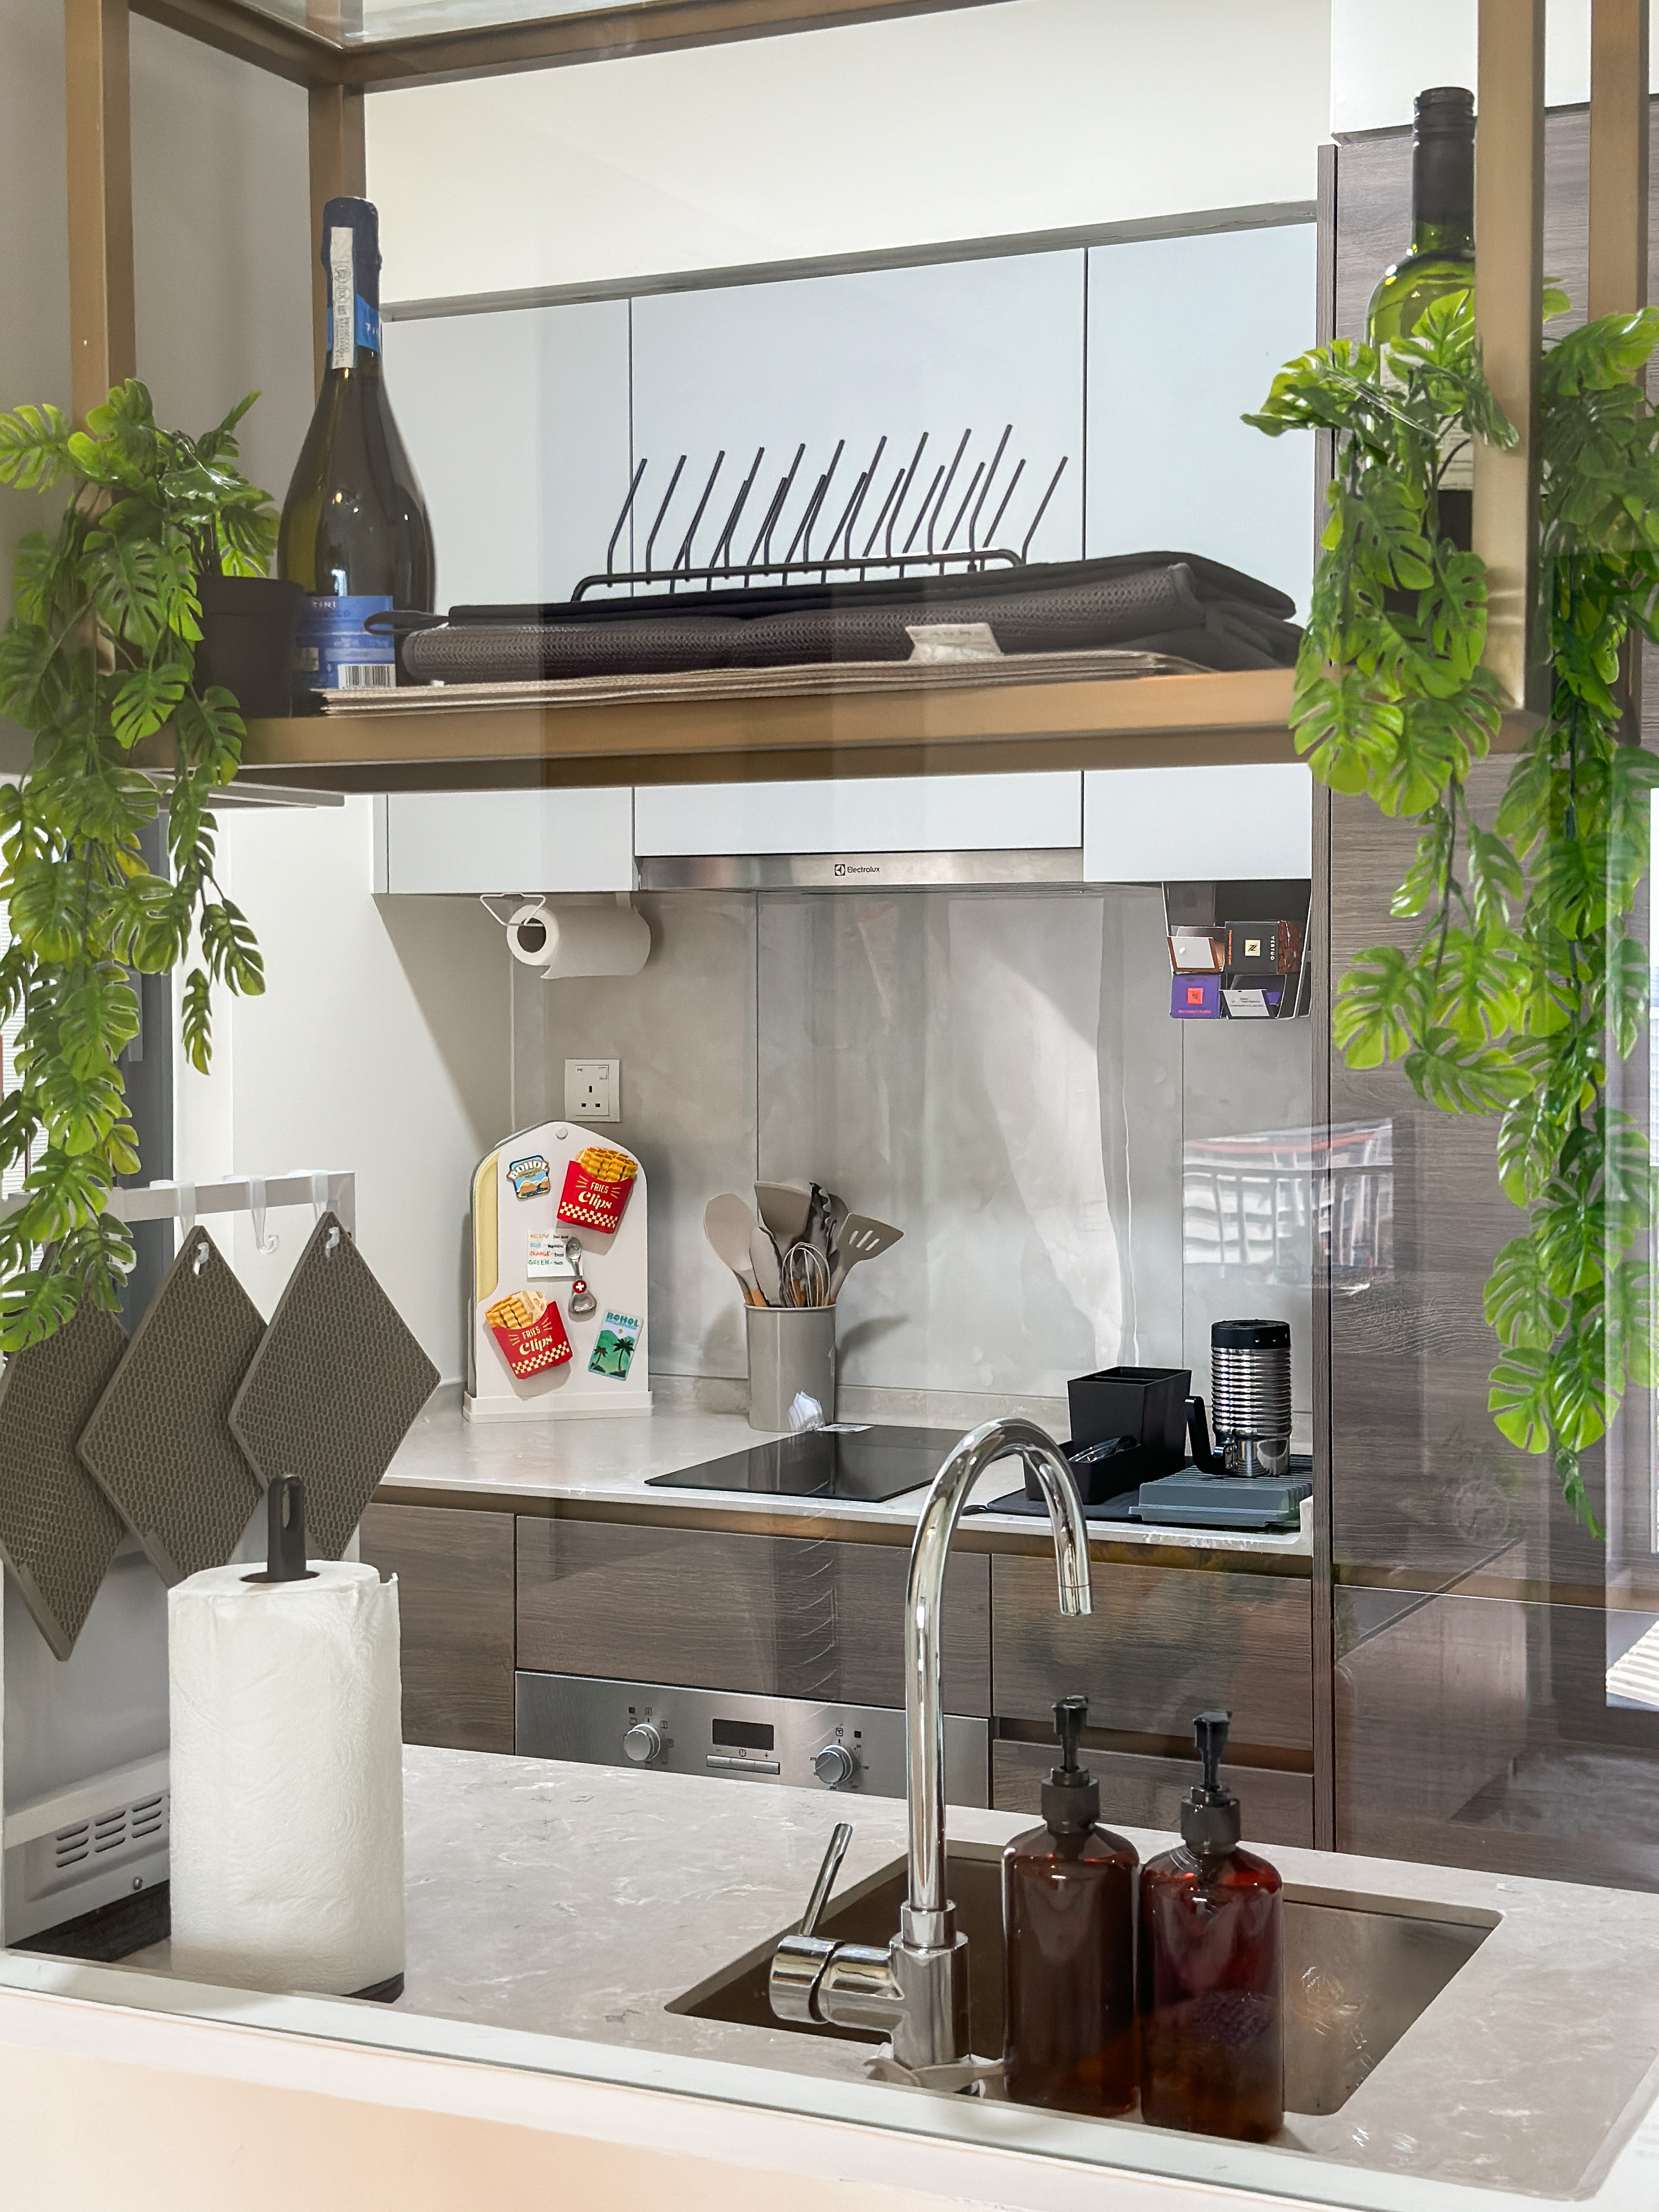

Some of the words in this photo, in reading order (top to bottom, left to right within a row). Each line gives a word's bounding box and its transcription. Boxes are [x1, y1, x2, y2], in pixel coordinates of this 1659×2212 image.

[509, 1160, 549, 1180] BOHOL
[590, 1182, 610, 1194] FRIES
[578, 1190, 613, 1210] Clips
[607, 1312, 639, 1327] BOHOL
[522, 1326, 541, 1340] FRIES
[518, 1334, 553, 1355] Clips
